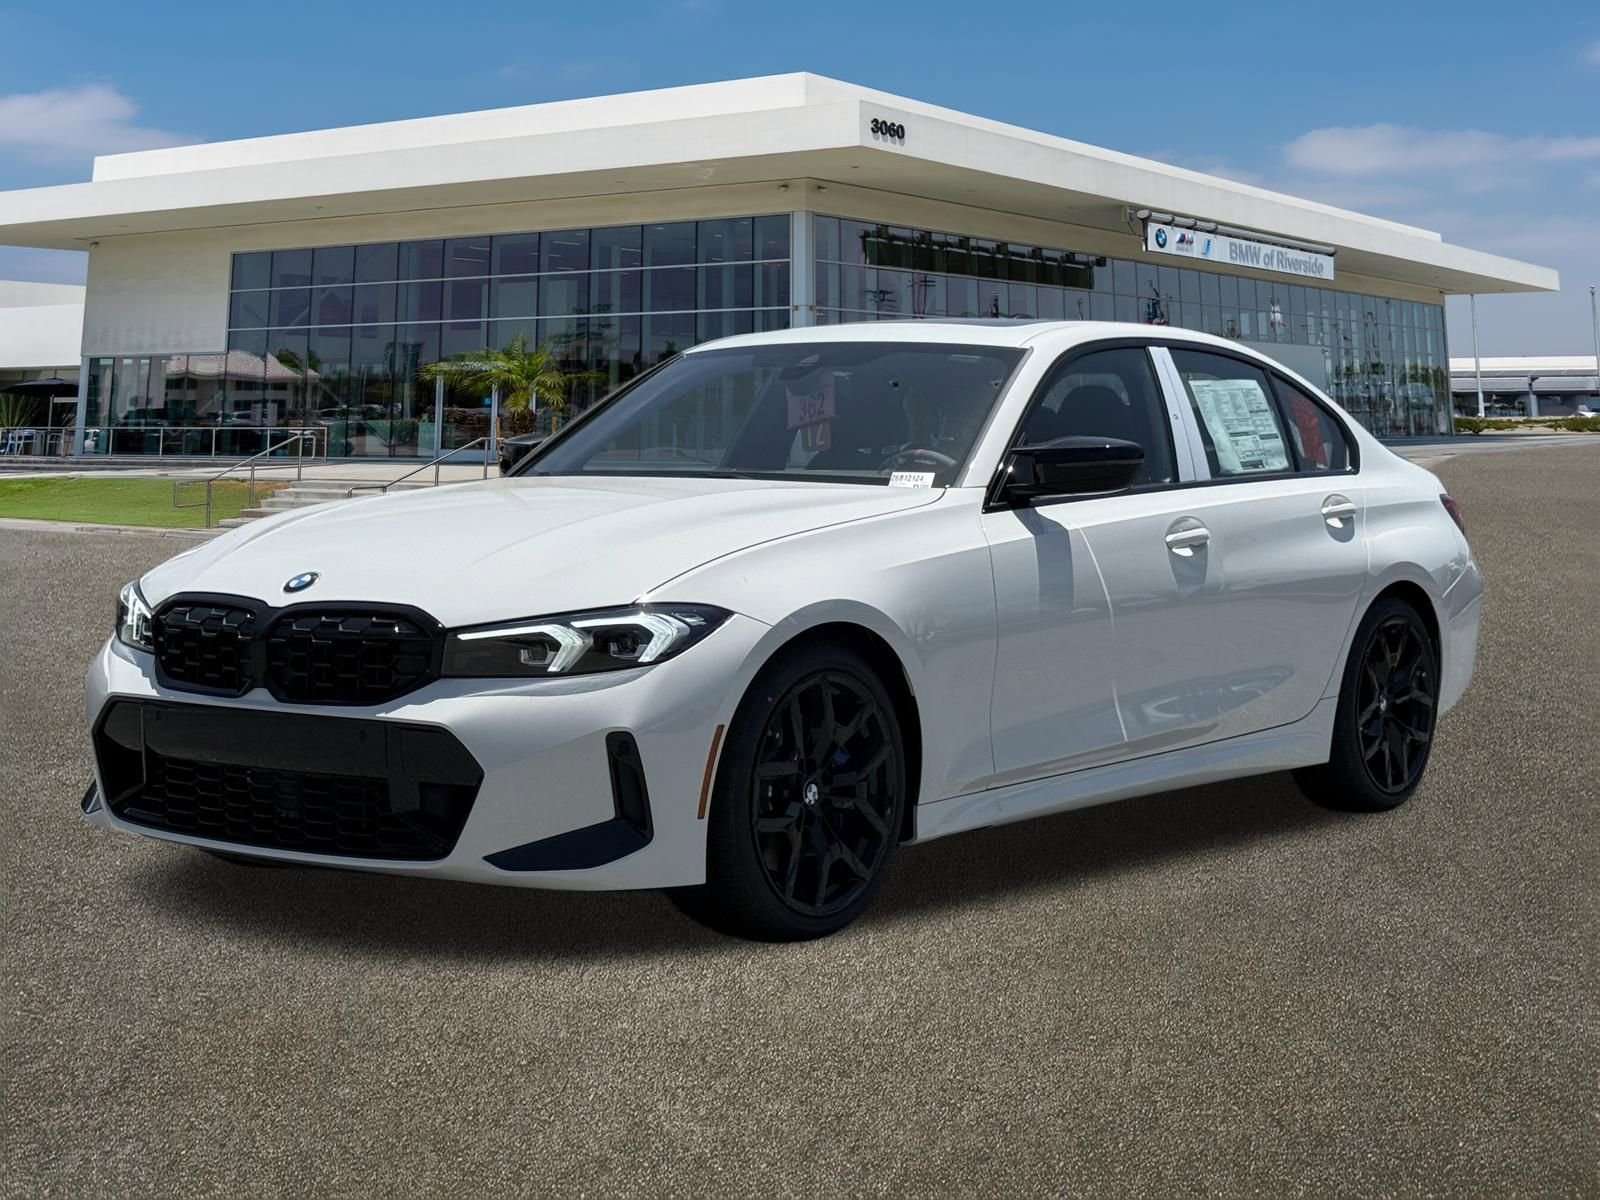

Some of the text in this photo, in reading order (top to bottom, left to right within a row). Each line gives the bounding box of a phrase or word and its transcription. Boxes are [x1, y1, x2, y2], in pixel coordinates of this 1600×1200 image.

[871, 118, 905, 139] 3060
[1229, 241, 1261, 265] BMW
[1263, 249, 1275, 267] of
[1276, 250, 1324, 275] Riverside
[799, 392, 825, 421] 362
